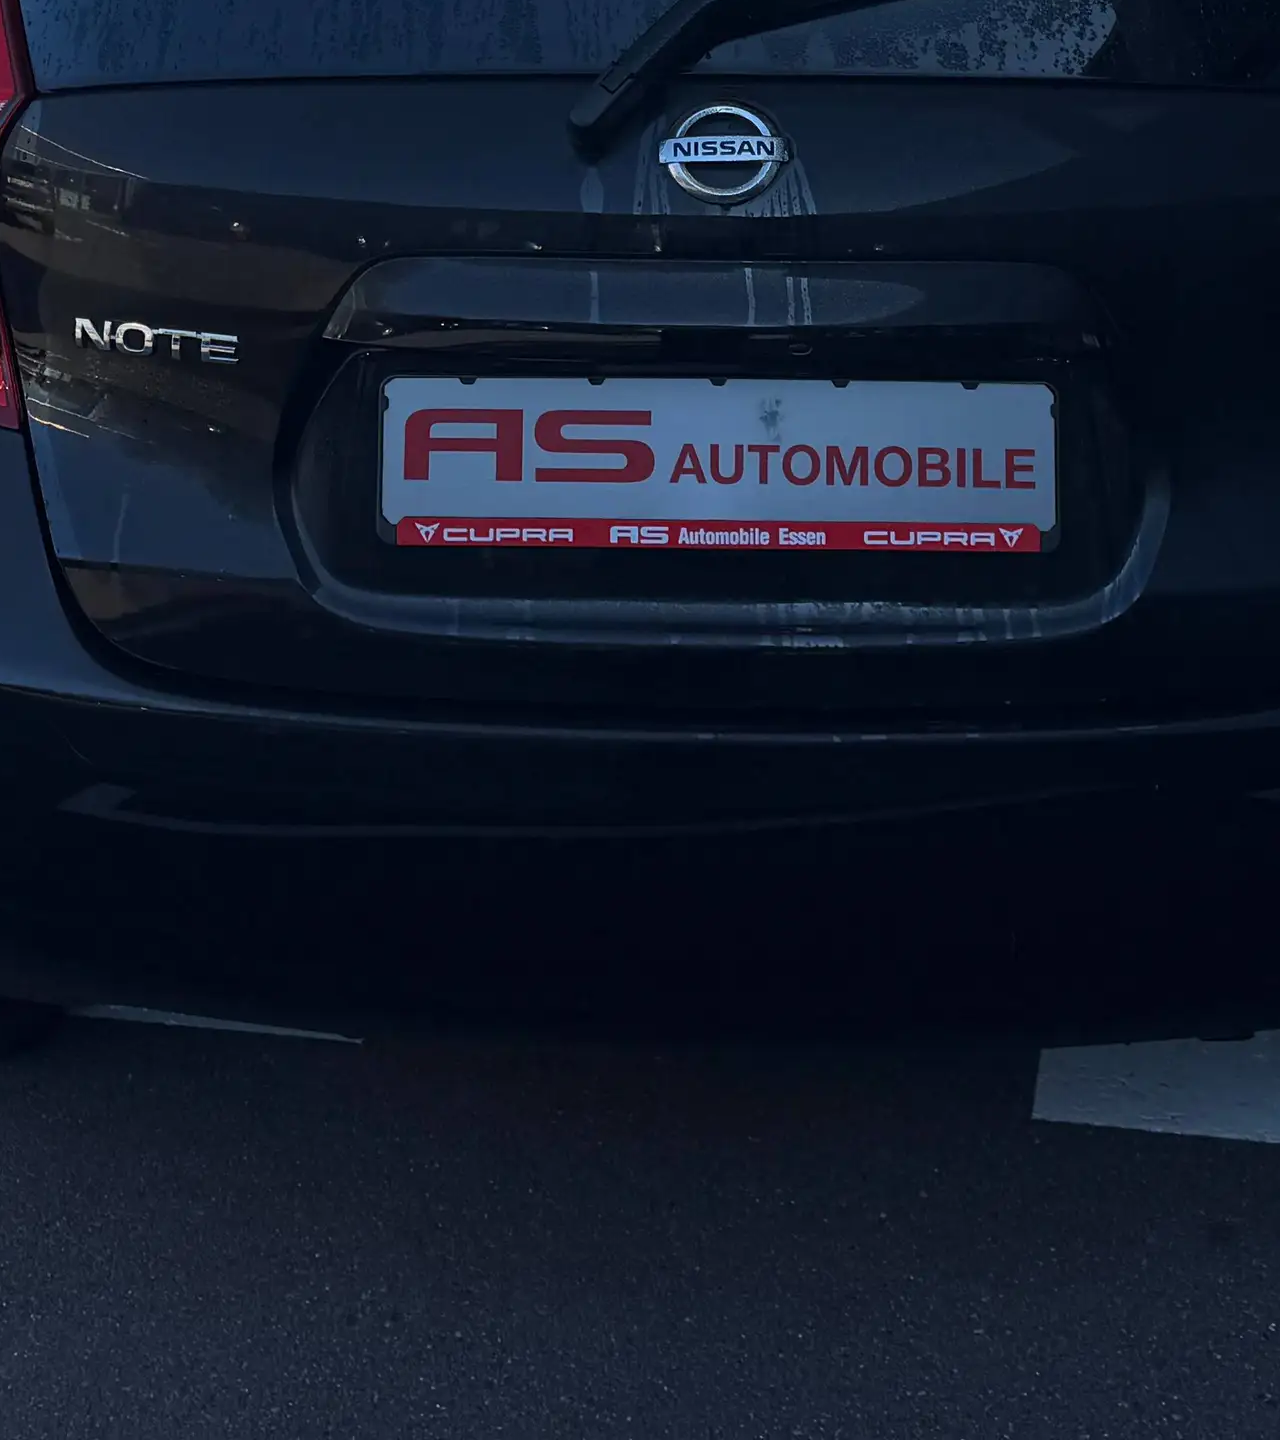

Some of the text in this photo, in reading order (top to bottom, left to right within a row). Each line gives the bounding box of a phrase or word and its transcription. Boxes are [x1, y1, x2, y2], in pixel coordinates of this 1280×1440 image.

[673, 140, 775, 158] NISSAN
[75, 317, 240, 365] NOTE
[403, 408, 1037, 491] AS AUTOMOBILE
[442, 525, 996, 547] CUPRA AS Automobile Essen CUPRA
